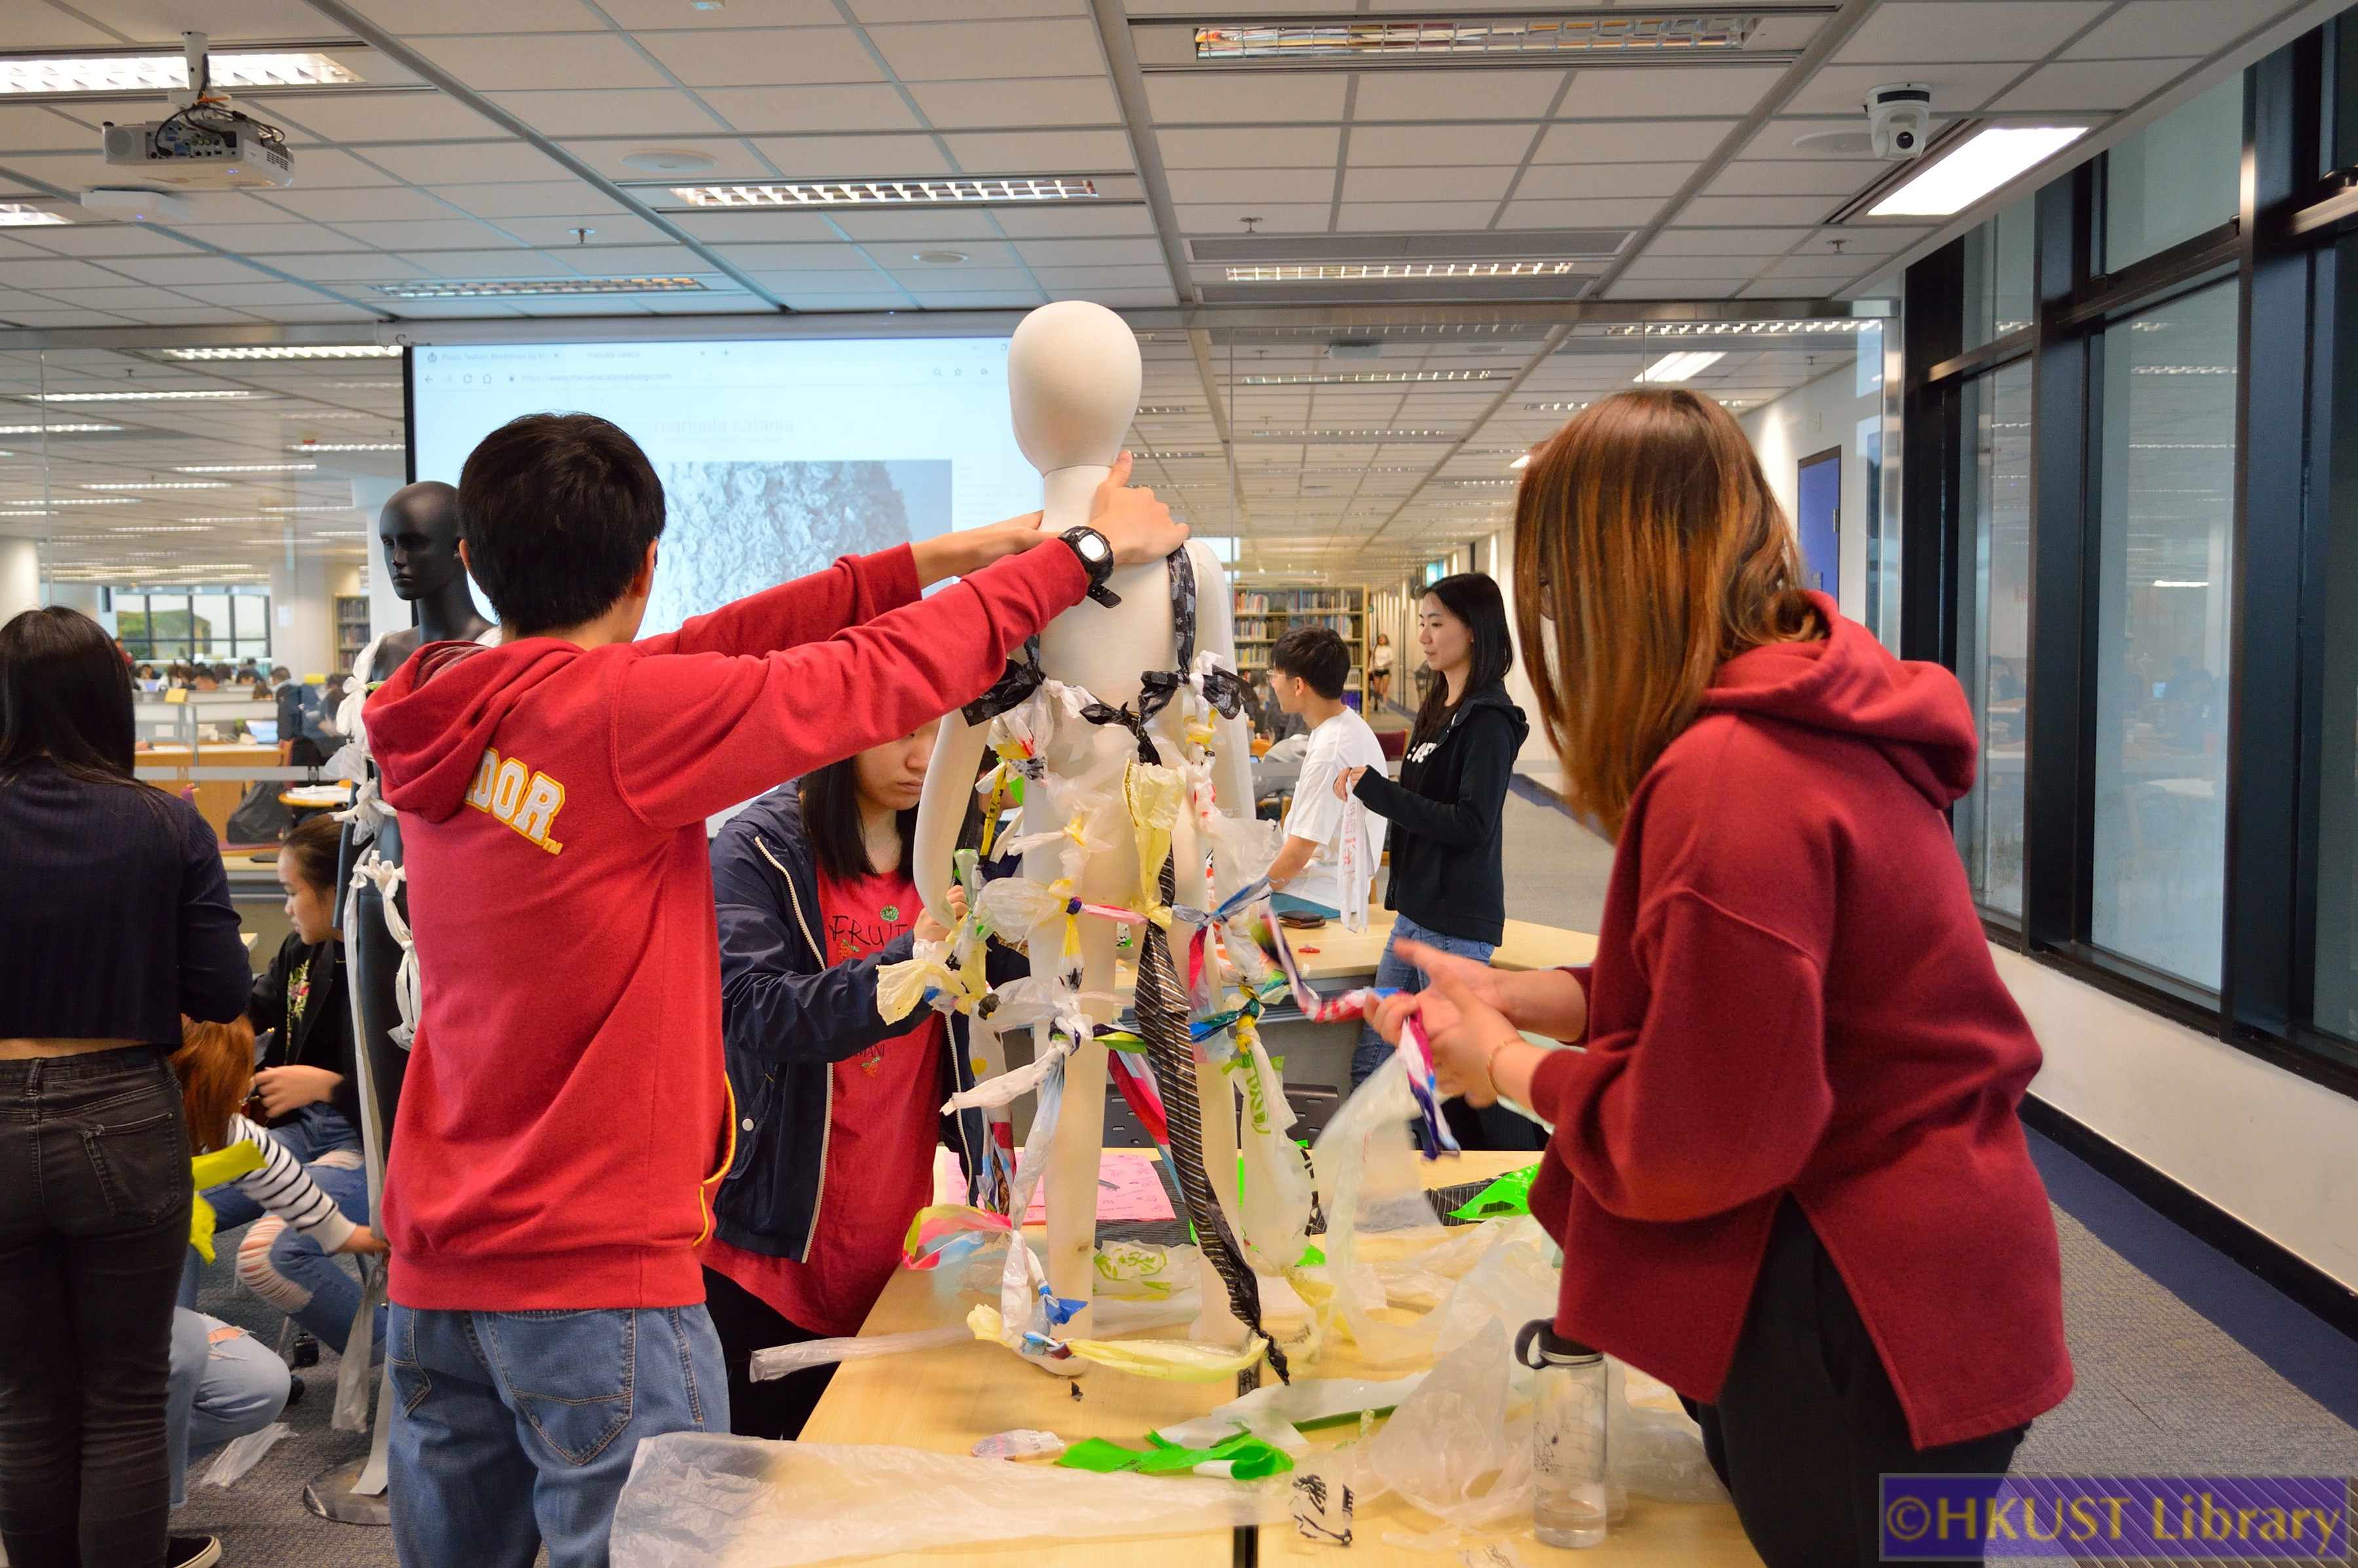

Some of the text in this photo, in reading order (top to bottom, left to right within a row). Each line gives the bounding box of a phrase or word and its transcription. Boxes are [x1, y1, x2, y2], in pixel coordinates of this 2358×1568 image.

[654, 417, 795, 432] manuela catania
[464, 746, 566, 846] DOR
[829, 915, 908, 947] FRUIT
